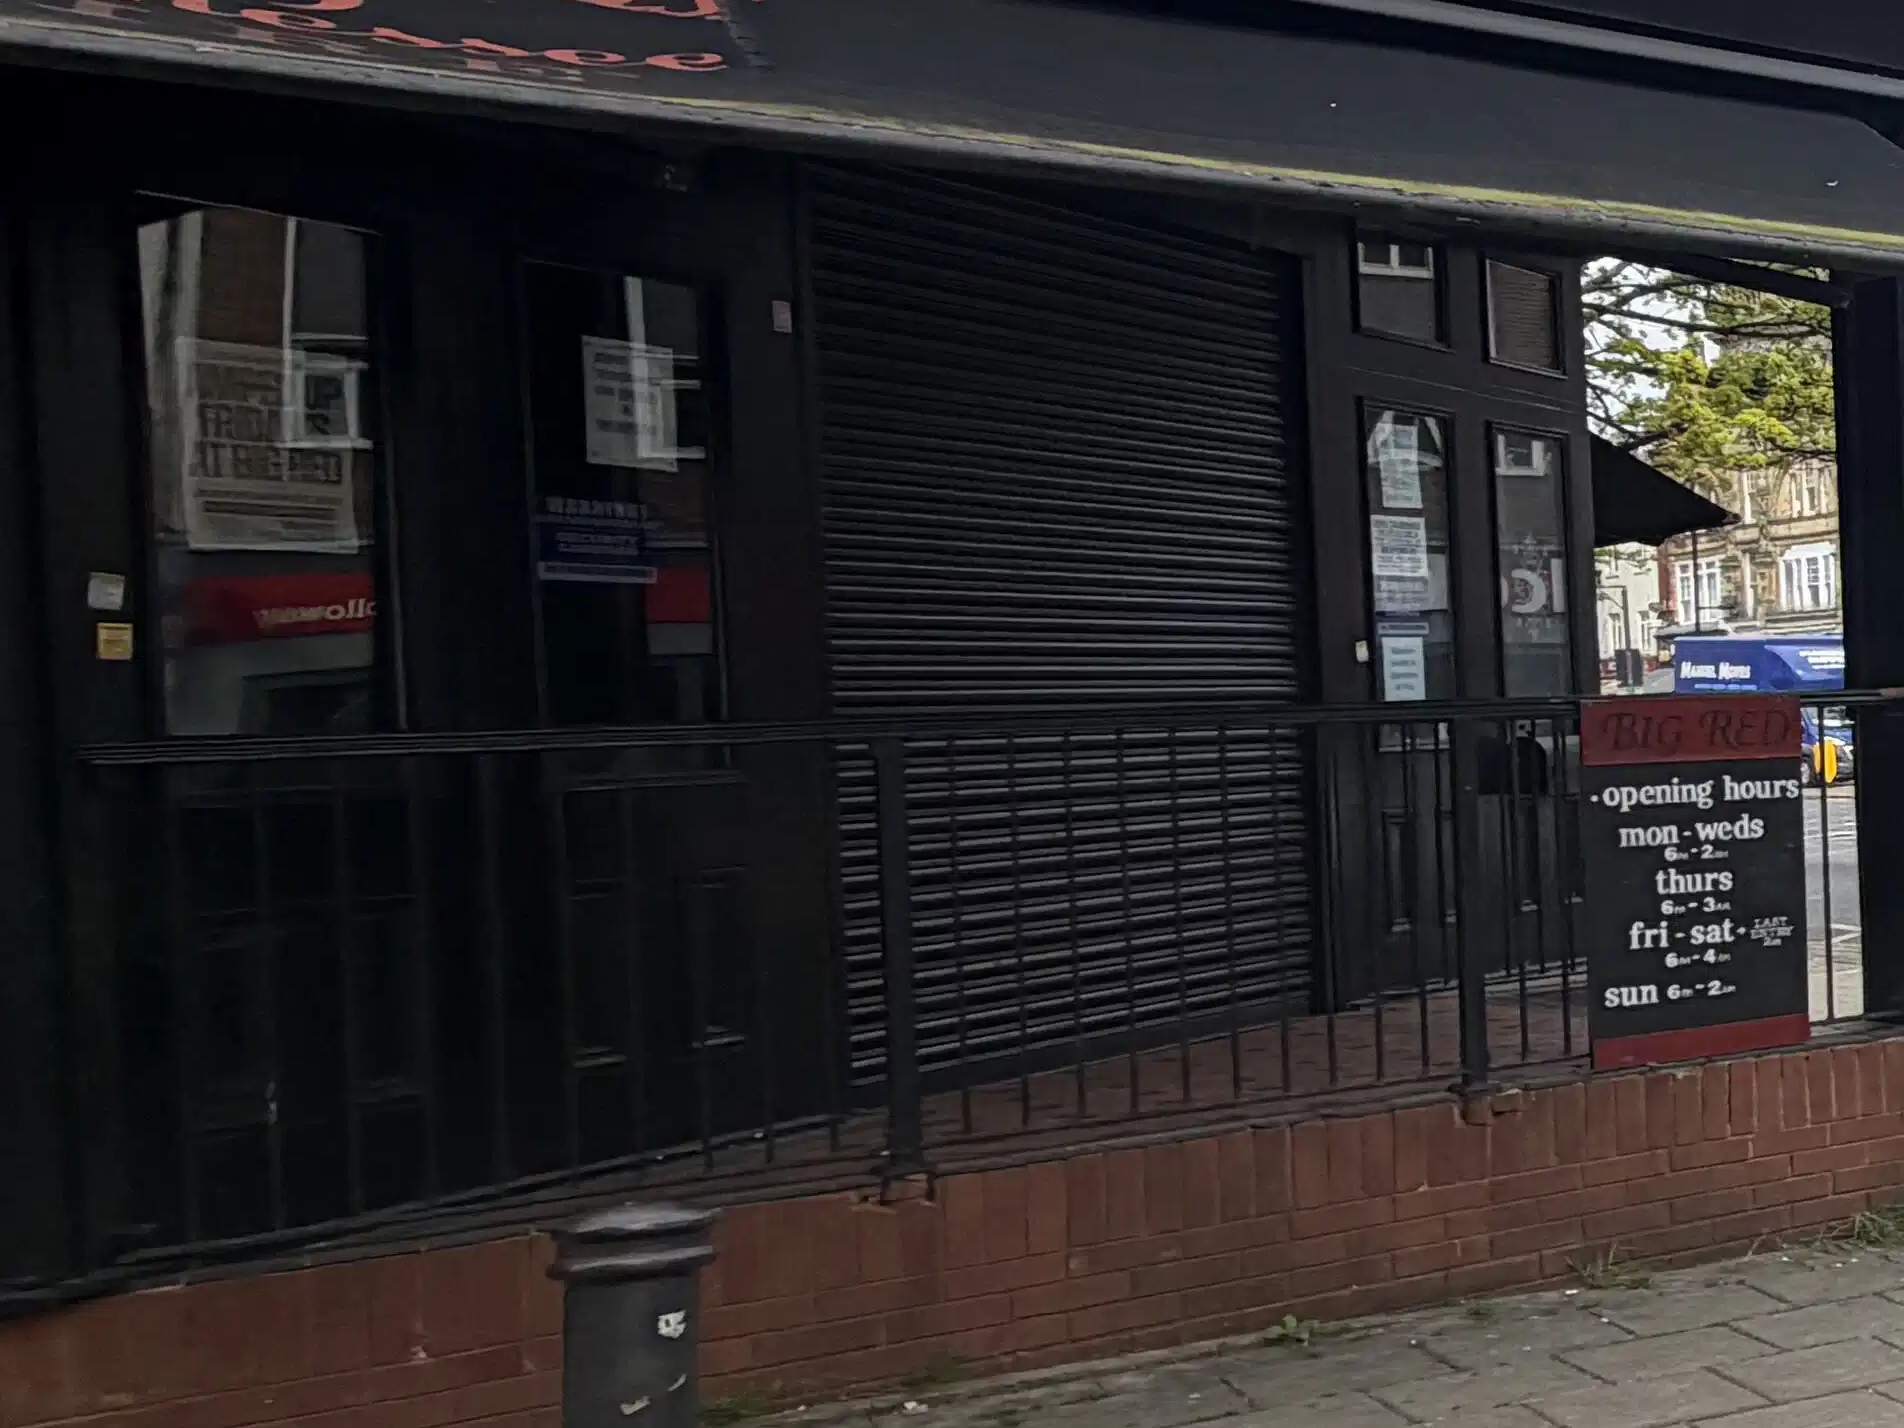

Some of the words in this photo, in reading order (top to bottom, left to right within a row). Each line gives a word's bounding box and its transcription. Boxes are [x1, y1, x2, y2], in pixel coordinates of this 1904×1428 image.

[1603, 710, 1684, 758] BIG
[1699, 707, 1791, 751] RED
[1602, 776, 1715, 813] opening
[1722, 774, 1800, 802] hours
[1655, 867, 1734, 895] thurs
[1604, 983, 1660, 1008] sun
